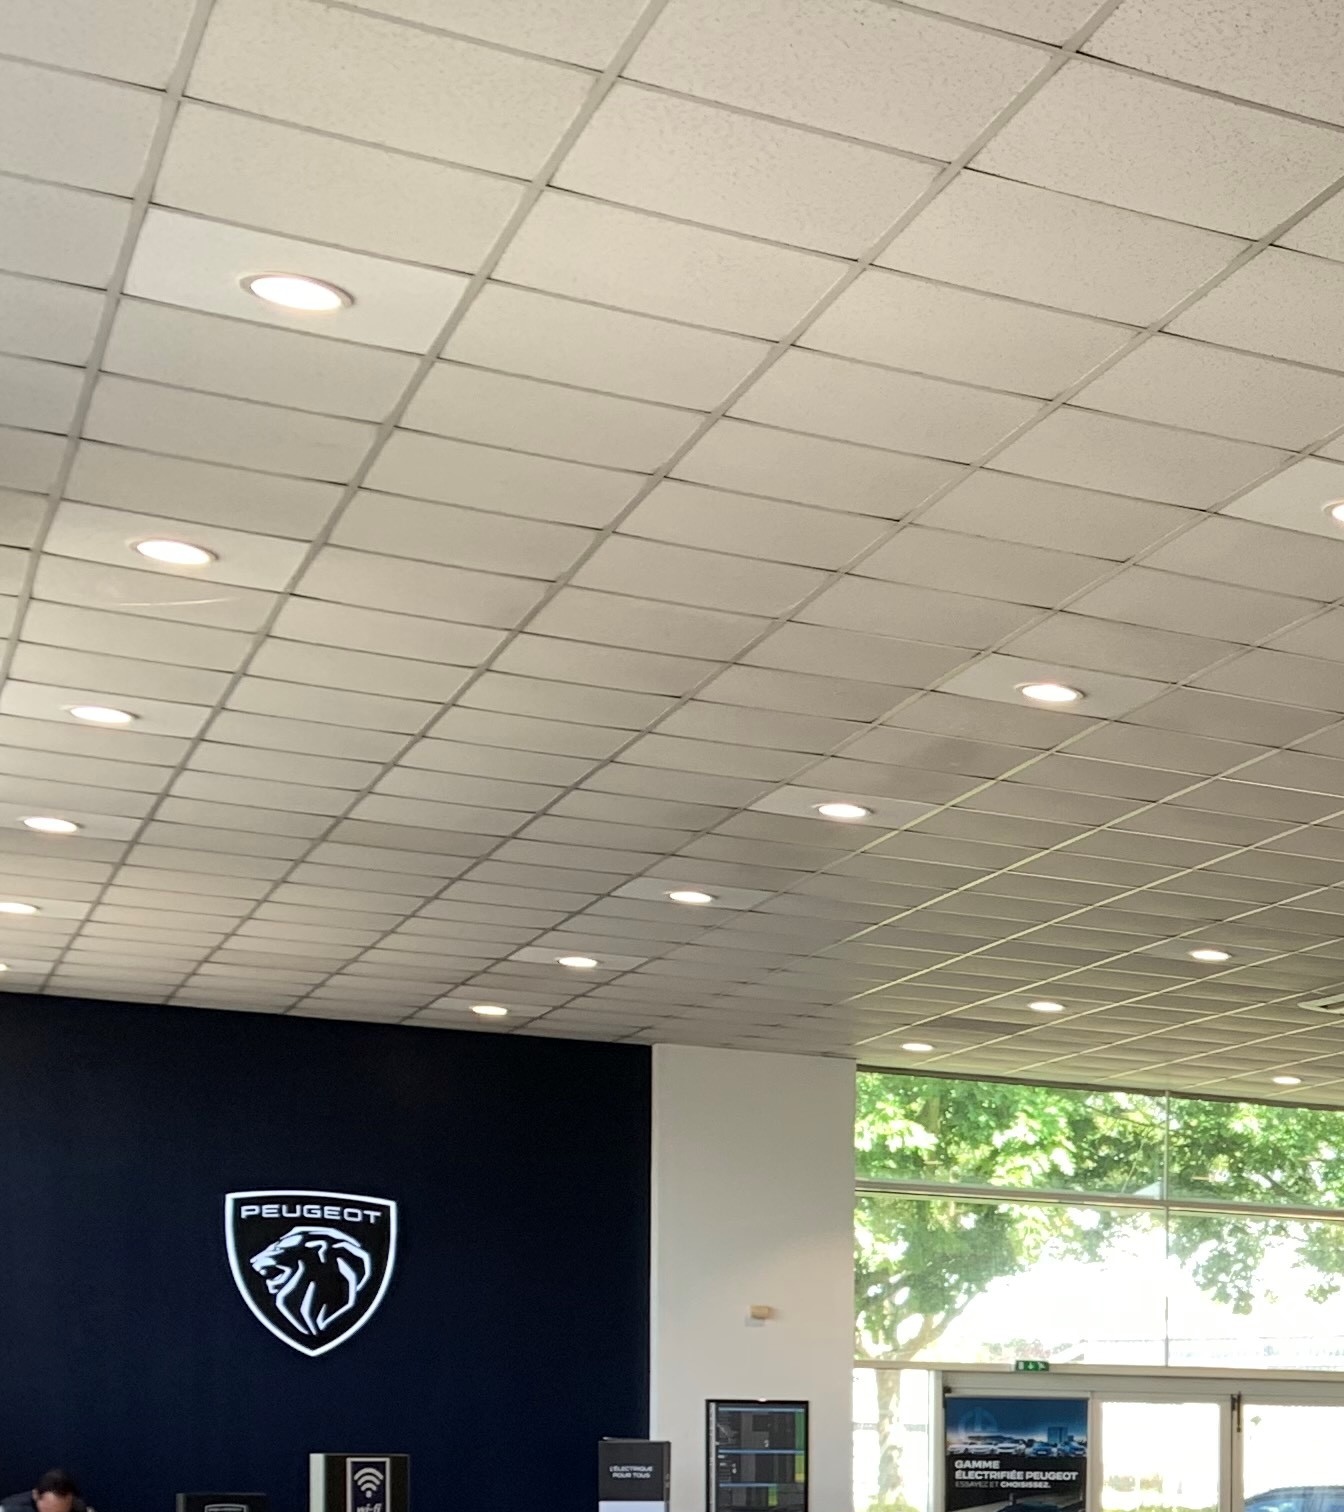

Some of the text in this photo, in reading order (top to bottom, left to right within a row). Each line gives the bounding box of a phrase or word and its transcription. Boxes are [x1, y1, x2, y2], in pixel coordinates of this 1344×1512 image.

[240, 1203, 382, 1224] PEUGEOT
[954, 1460, 1000, 1470] GAMME
[955, 1469, 1079, 1481] ÉLECTRIFIÉE PEUGEOT
